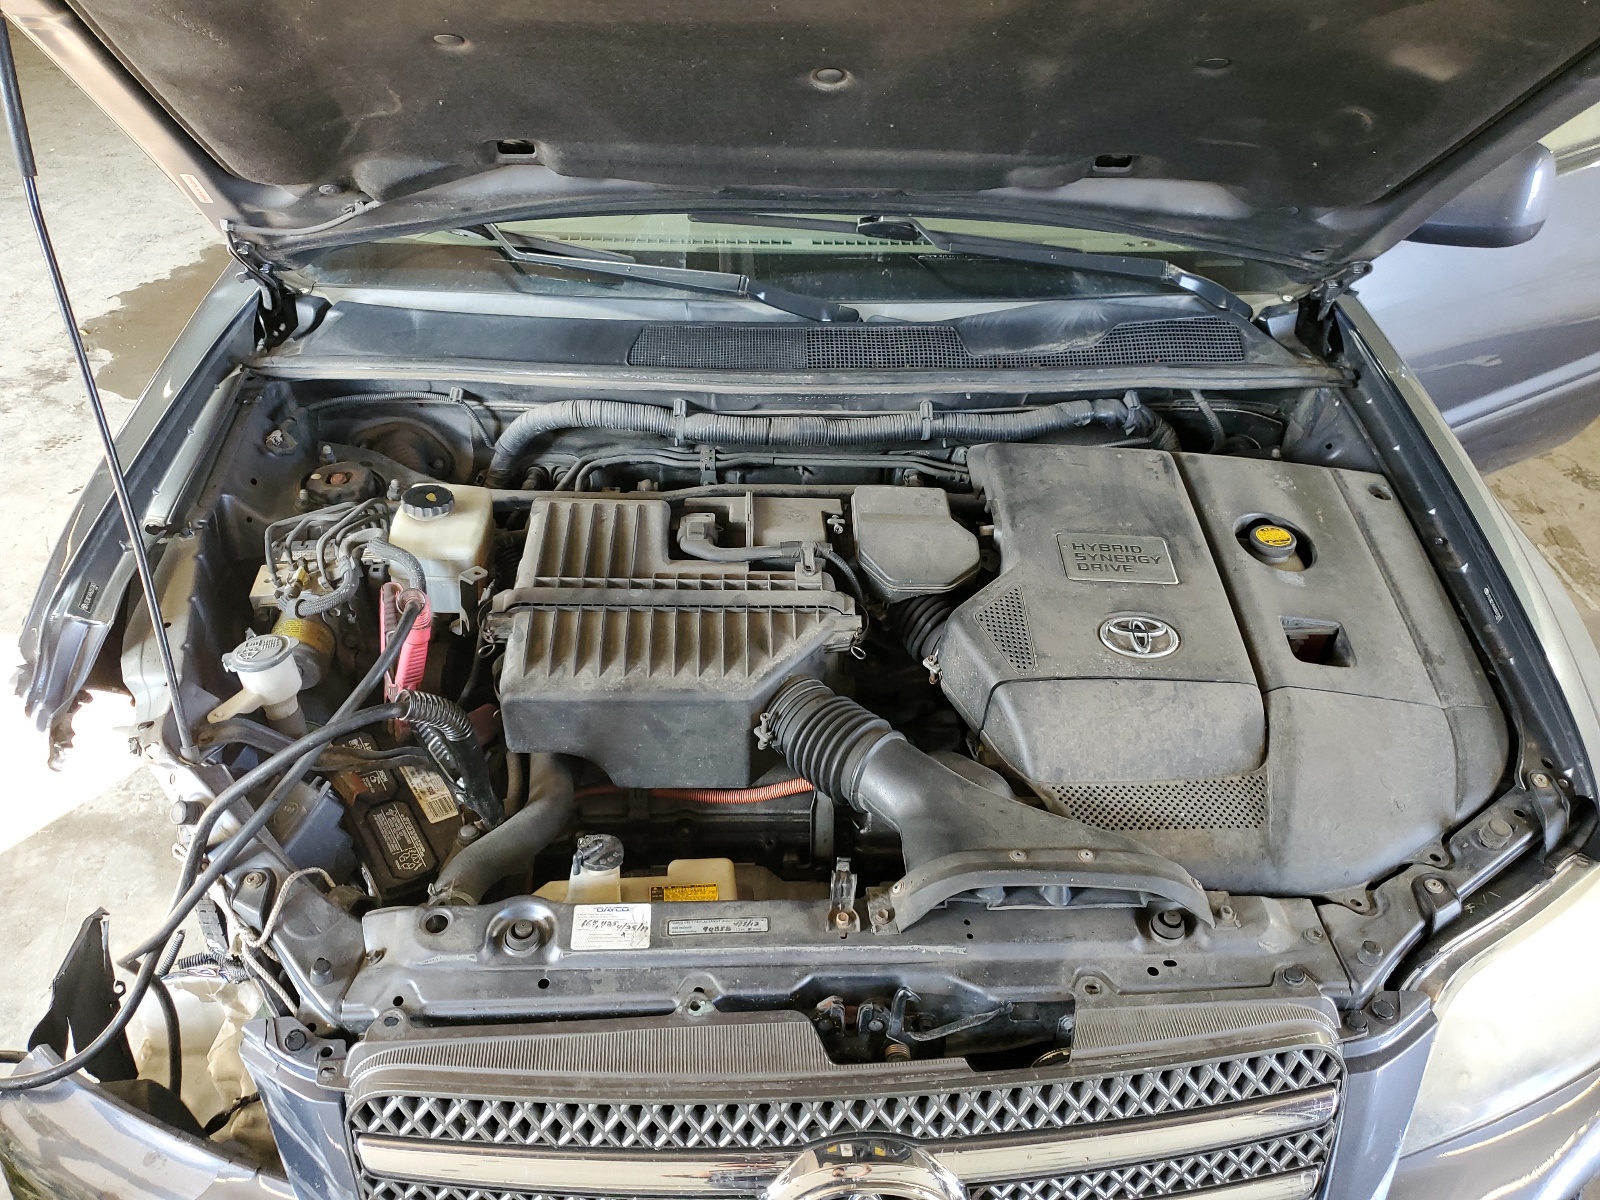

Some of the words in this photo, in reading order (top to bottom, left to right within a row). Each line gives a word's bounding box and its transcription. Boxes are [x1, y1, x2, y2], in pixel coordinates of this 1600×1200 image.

[1071, 542, 1143, 554] HYBRID
[1074, 552, 1162, 565] SYNERGY
[1076, 562, 1135, 573] DRIVE
